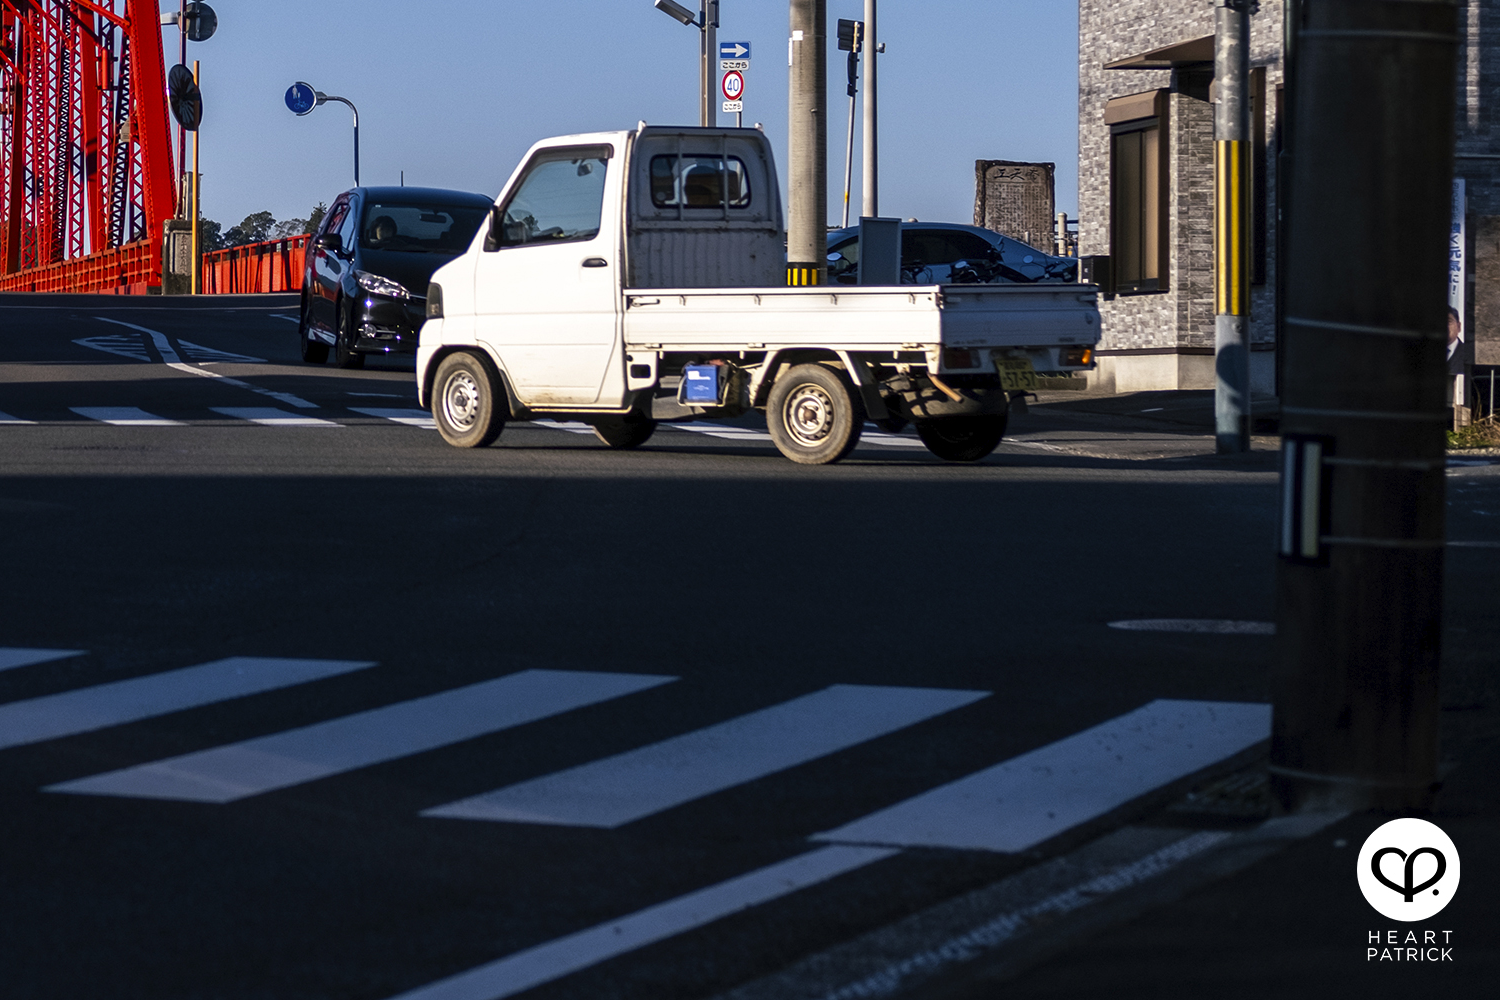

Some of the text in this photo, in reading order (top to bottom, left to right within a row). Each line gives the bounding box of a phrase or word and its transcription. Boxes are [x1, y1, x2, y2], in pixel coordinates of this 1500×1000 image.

[727, 78, 739, 92] 40
[724, 103, 741, 111] ここから
